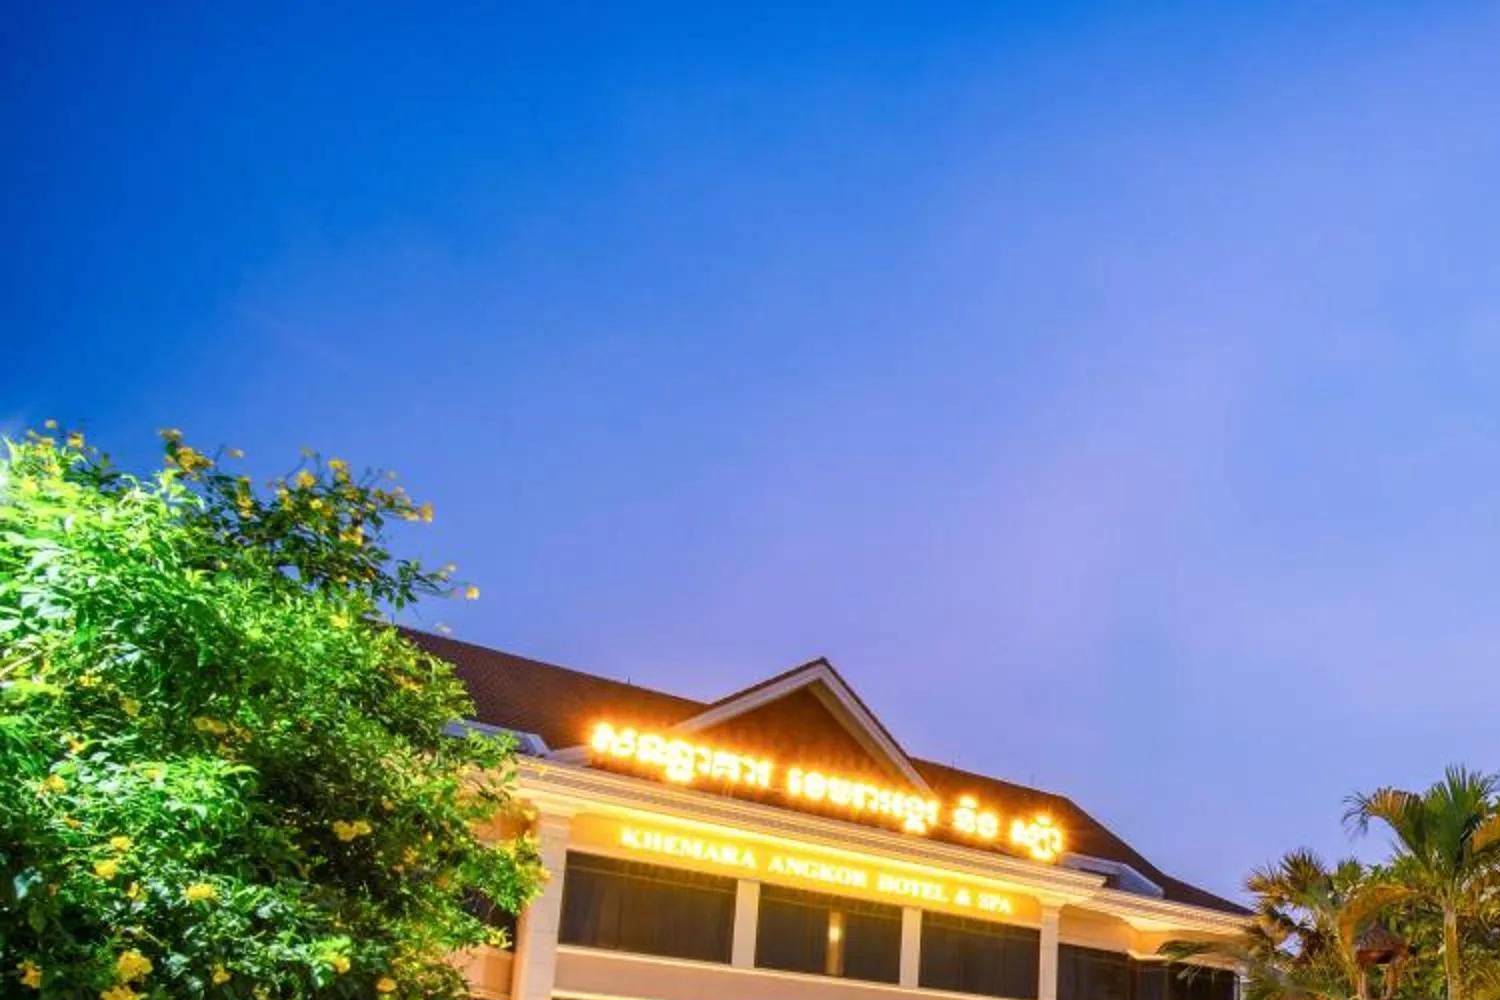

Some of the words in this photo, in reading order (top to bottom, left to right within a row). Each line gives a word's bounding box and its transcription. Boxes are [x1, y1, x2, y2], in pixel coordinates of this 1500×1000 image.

[620, 825, 758, 870] KHEMARA
[767, 855, 868, 888] ANGKOR
[876, 873, 950, 903] HOTEL
[953, 887, 973, 907] &
[977, 891, 1013, 915] SPA
